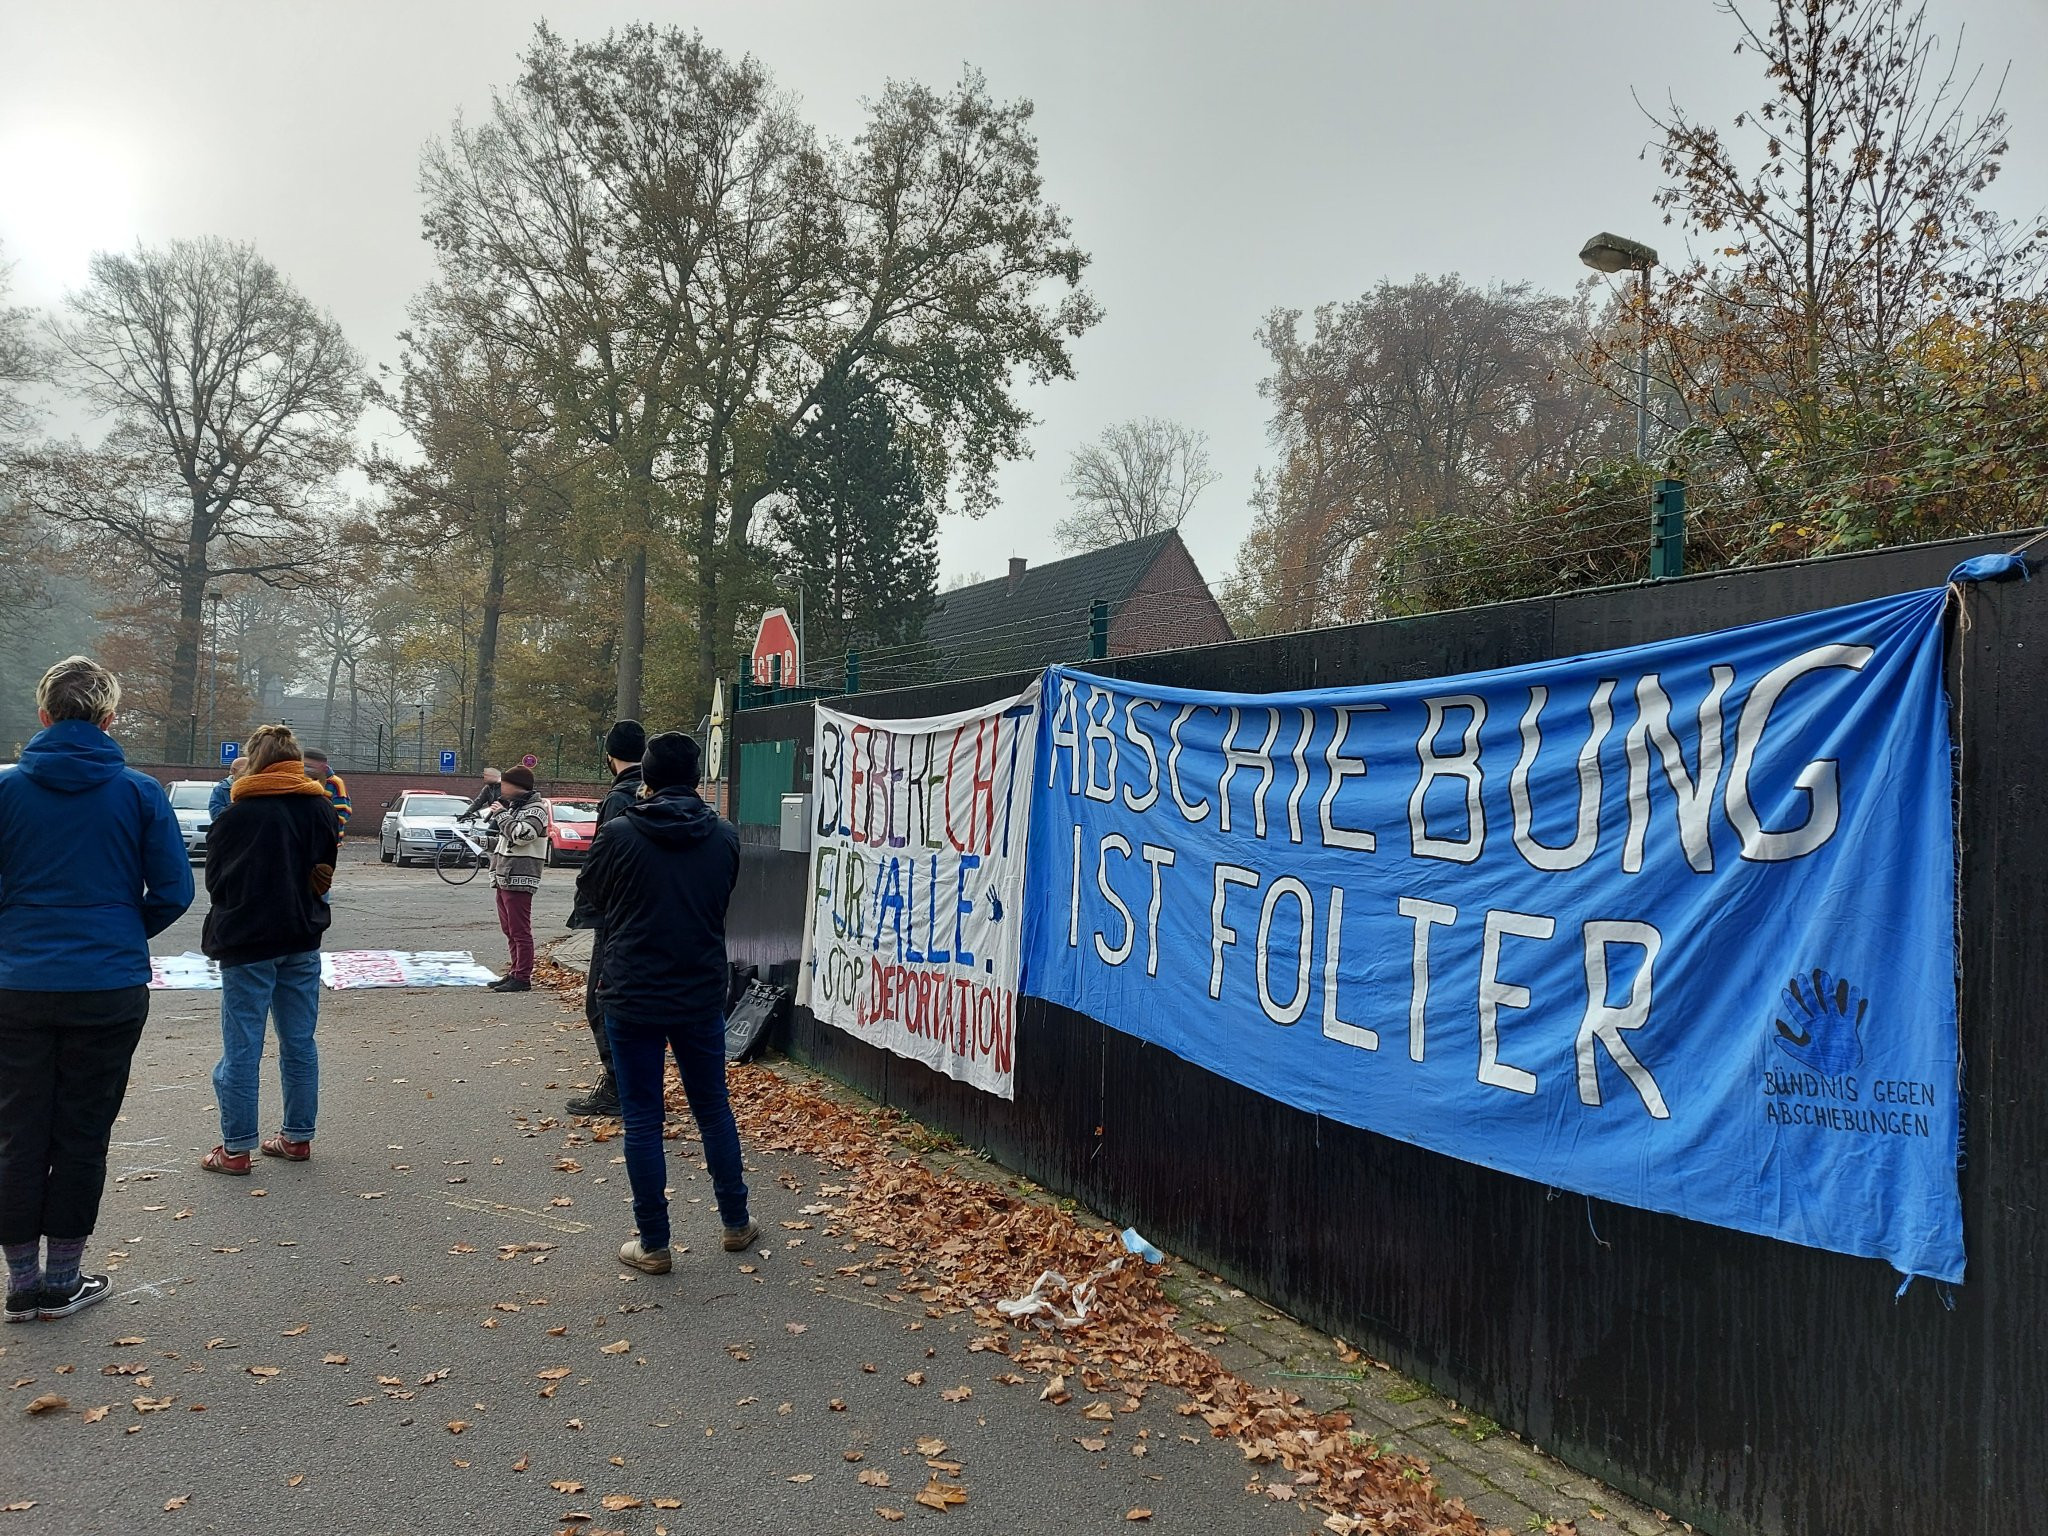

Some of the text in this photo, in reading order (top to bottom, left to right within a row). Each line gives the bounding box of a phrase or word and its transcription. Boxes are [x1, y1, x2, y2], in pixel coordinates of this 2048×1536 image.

[225, 744, 235, 756] P
[443, 752, 452, 764] P
[817, 705, 1034, 858] BLEIBERECHT
[1048, 643, 1875, 874] ABSCHIEBUNG
[813, 841, 866, 939] FÜR
[822, 944, 1012, 1073] STOP DEPORTATION
[1069, 824, 1671, 1119] IST FOLTER
[1763, 1066, 1936, 1107] BÜNDNIS GEGEN
[1766, 1101, 1930, 1138] ABSCHIEBUNGEN
